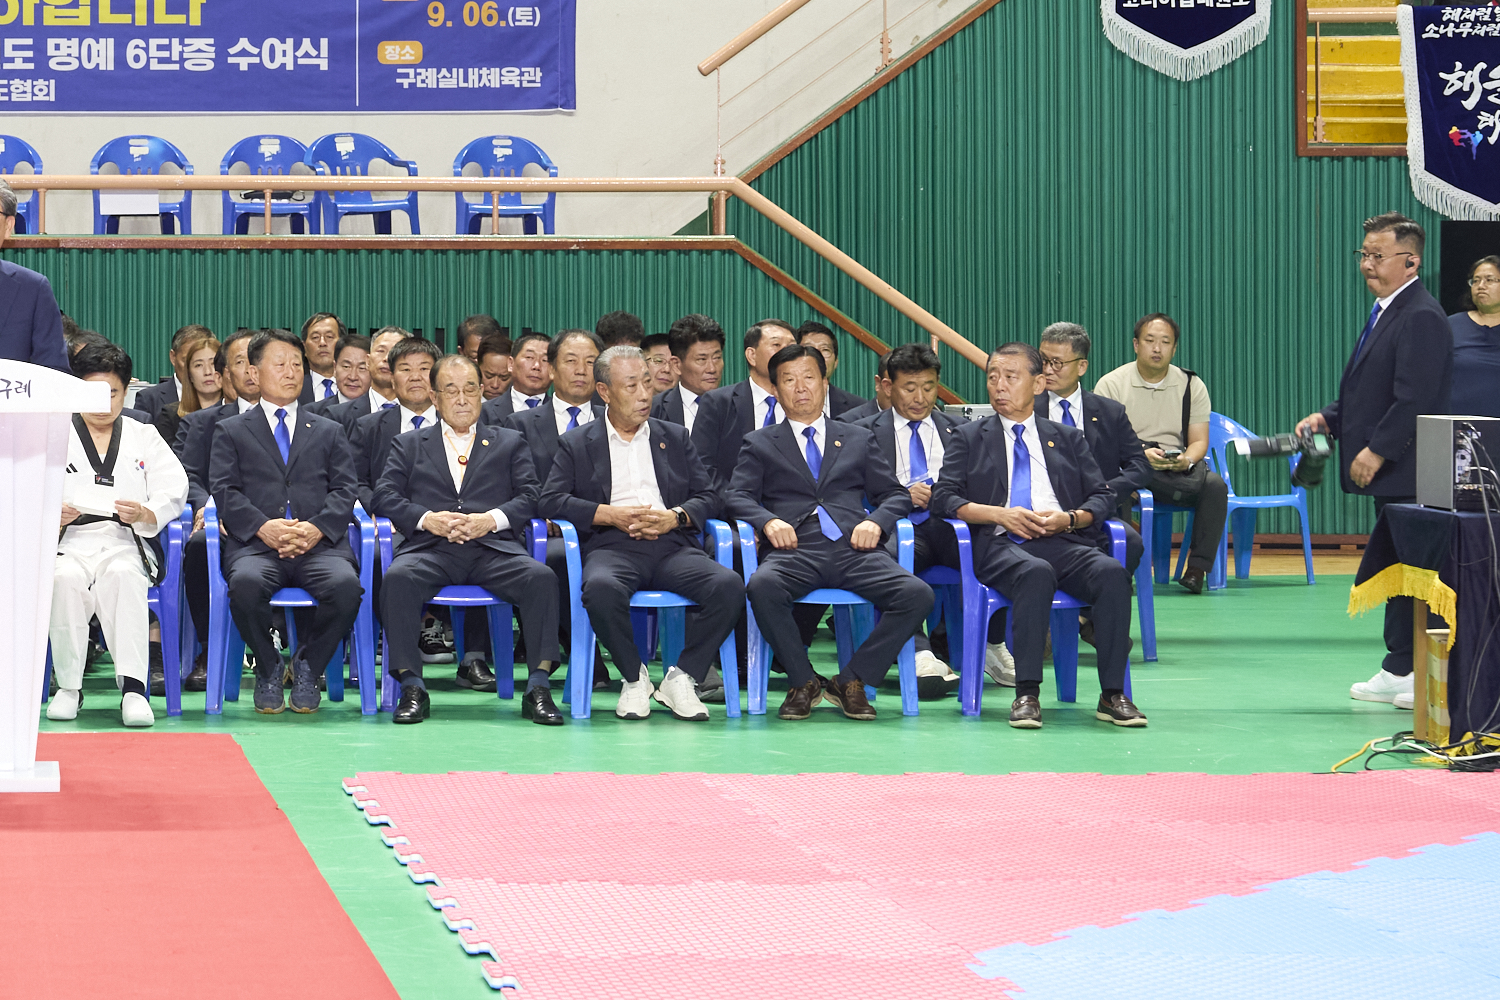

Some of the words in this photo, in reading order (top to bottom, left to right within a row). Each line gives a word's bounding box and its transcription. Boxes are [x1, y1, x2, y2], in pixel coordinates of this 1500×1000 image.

[46, 37, 115, 72] 명예
[125, 37, 216, 72] 6단증
[227, 37, 329, 72] 수여식
[384, 45, 415, 61] 장소
[395, 67, 542, 89] 구례실내체육관
